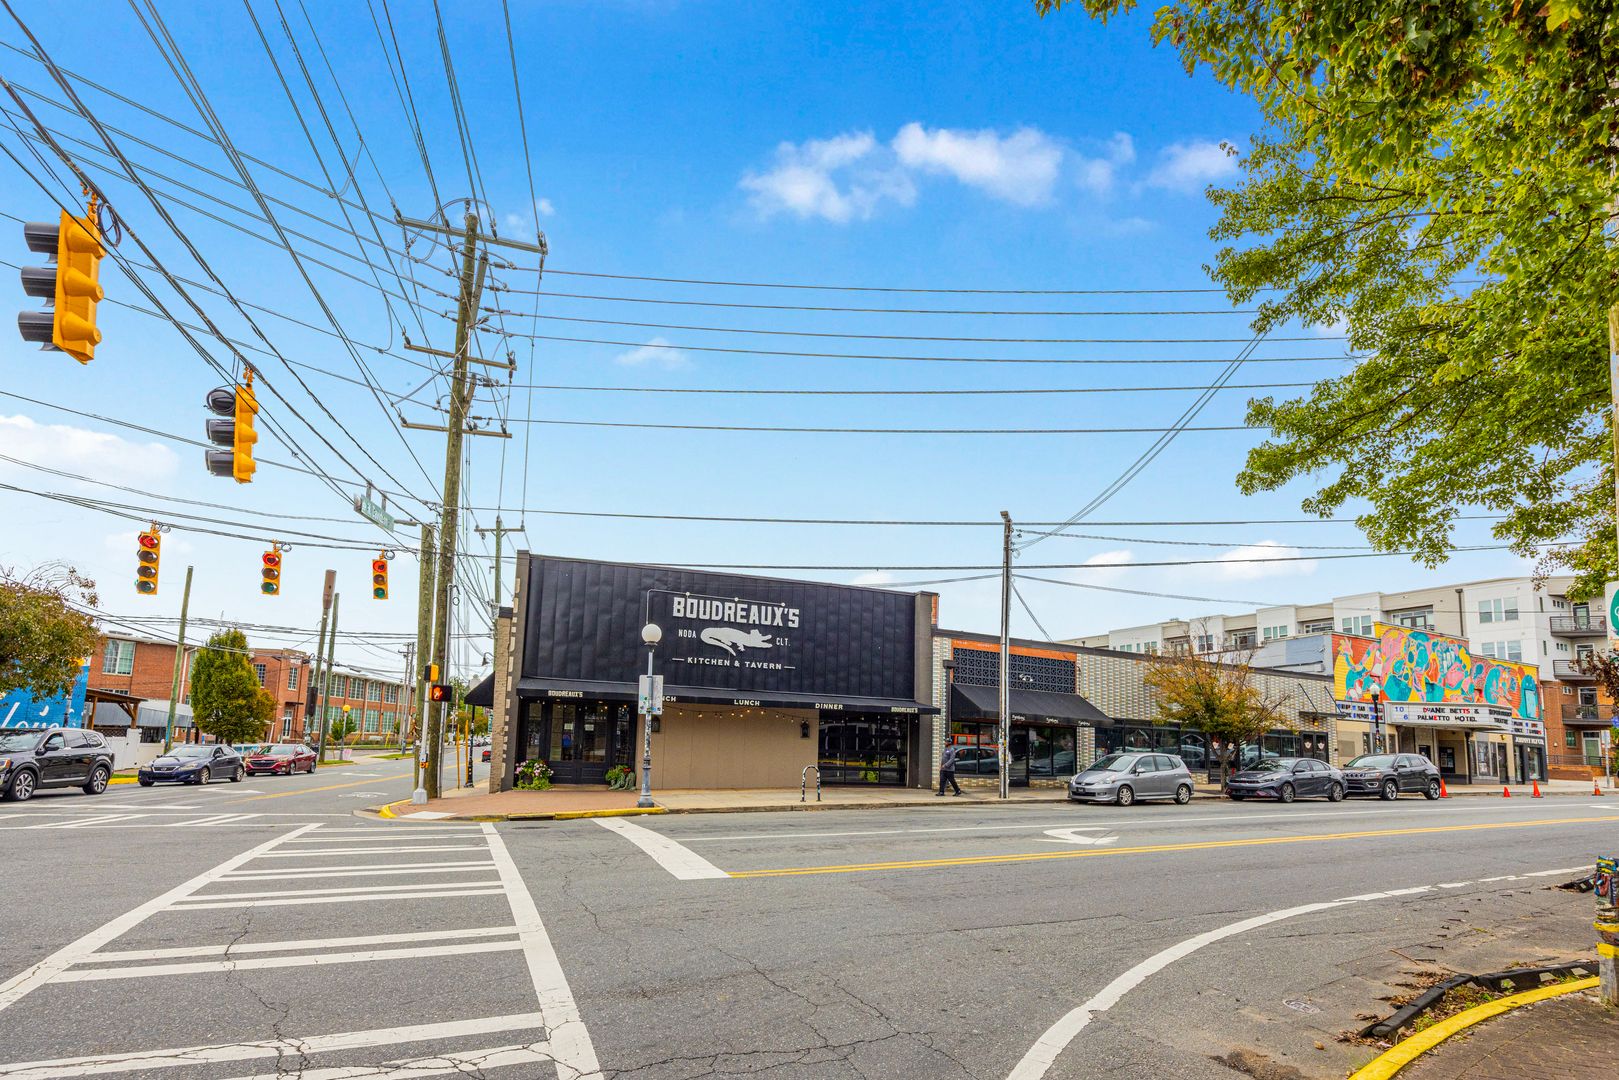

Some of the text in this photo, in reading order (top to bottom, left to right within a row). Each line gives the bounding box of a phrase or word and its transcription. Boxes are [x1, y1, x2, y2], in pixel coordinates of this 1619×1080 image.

[673, 597, 800, 628] BOUDREAUX'S
[678, 629, 697, 639] NODA
[776, 637, 791, 647] CLT.
[687, 657, 782, 670] KITCHEN & TAVERN
[734, 699, 760, 707] LUNCH
